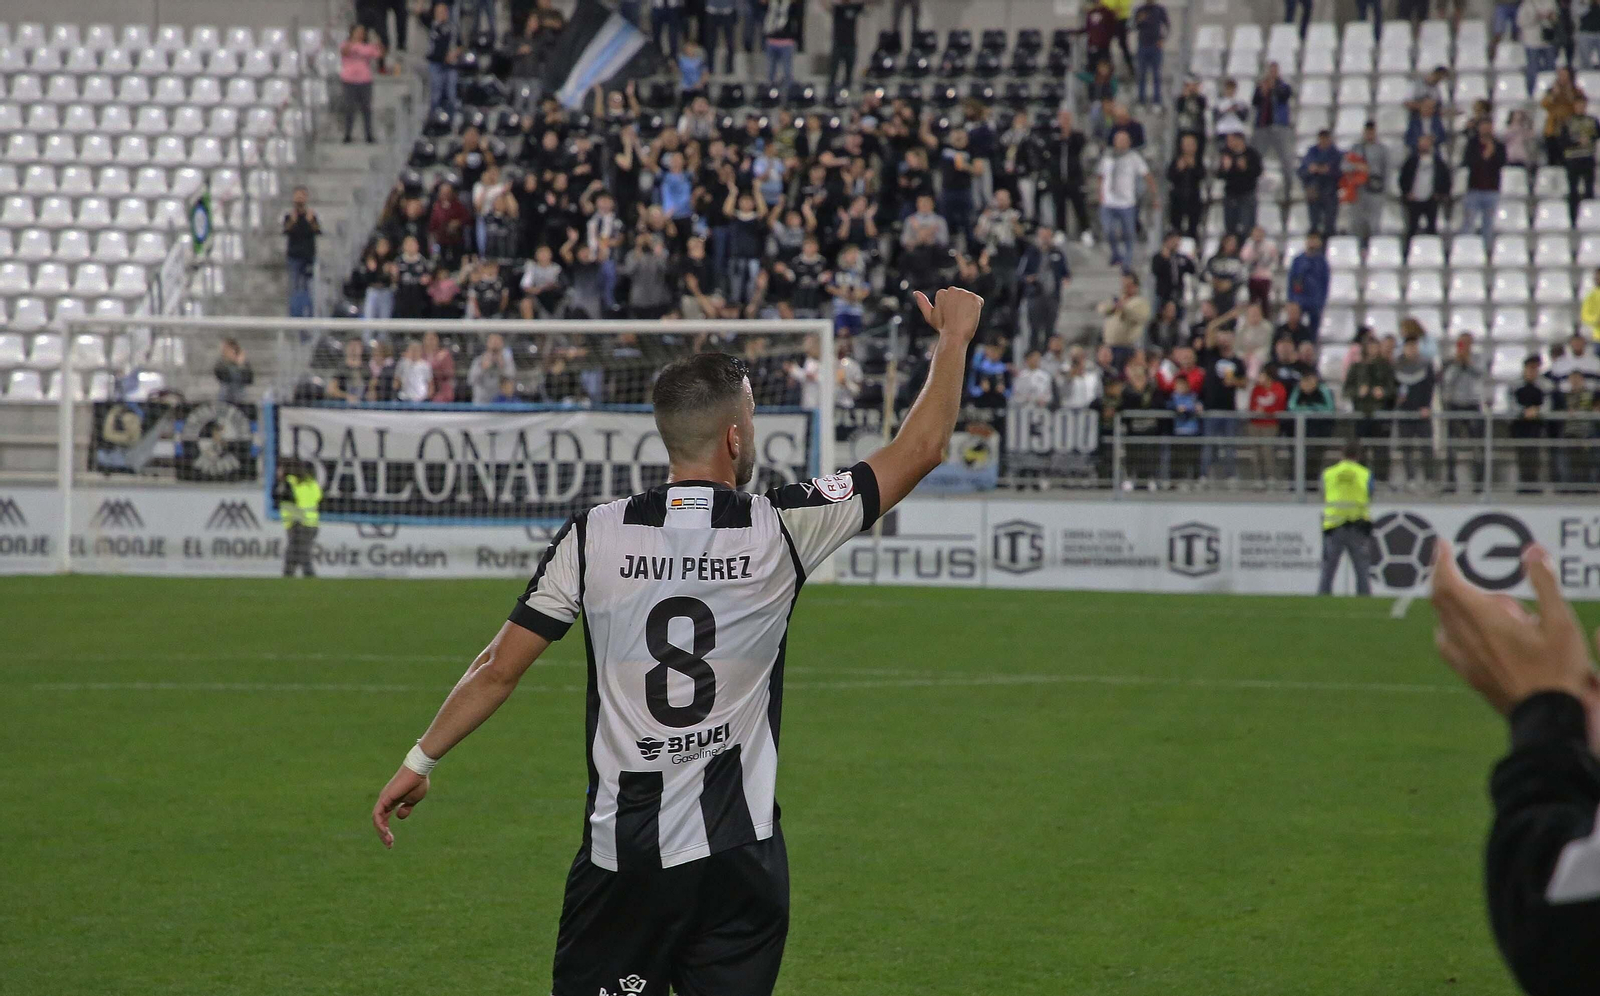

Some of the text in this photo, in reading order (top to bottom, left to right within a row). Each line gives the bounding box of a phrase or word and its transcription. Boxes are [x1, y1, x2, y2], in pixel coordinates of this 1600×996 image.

[184, 536, 202, 558] EL
[619, 552, 752, 580] JAVI PÉREZ
[839, 546, 976, 579] OTUS
[645, 595, 716, 728] 8
